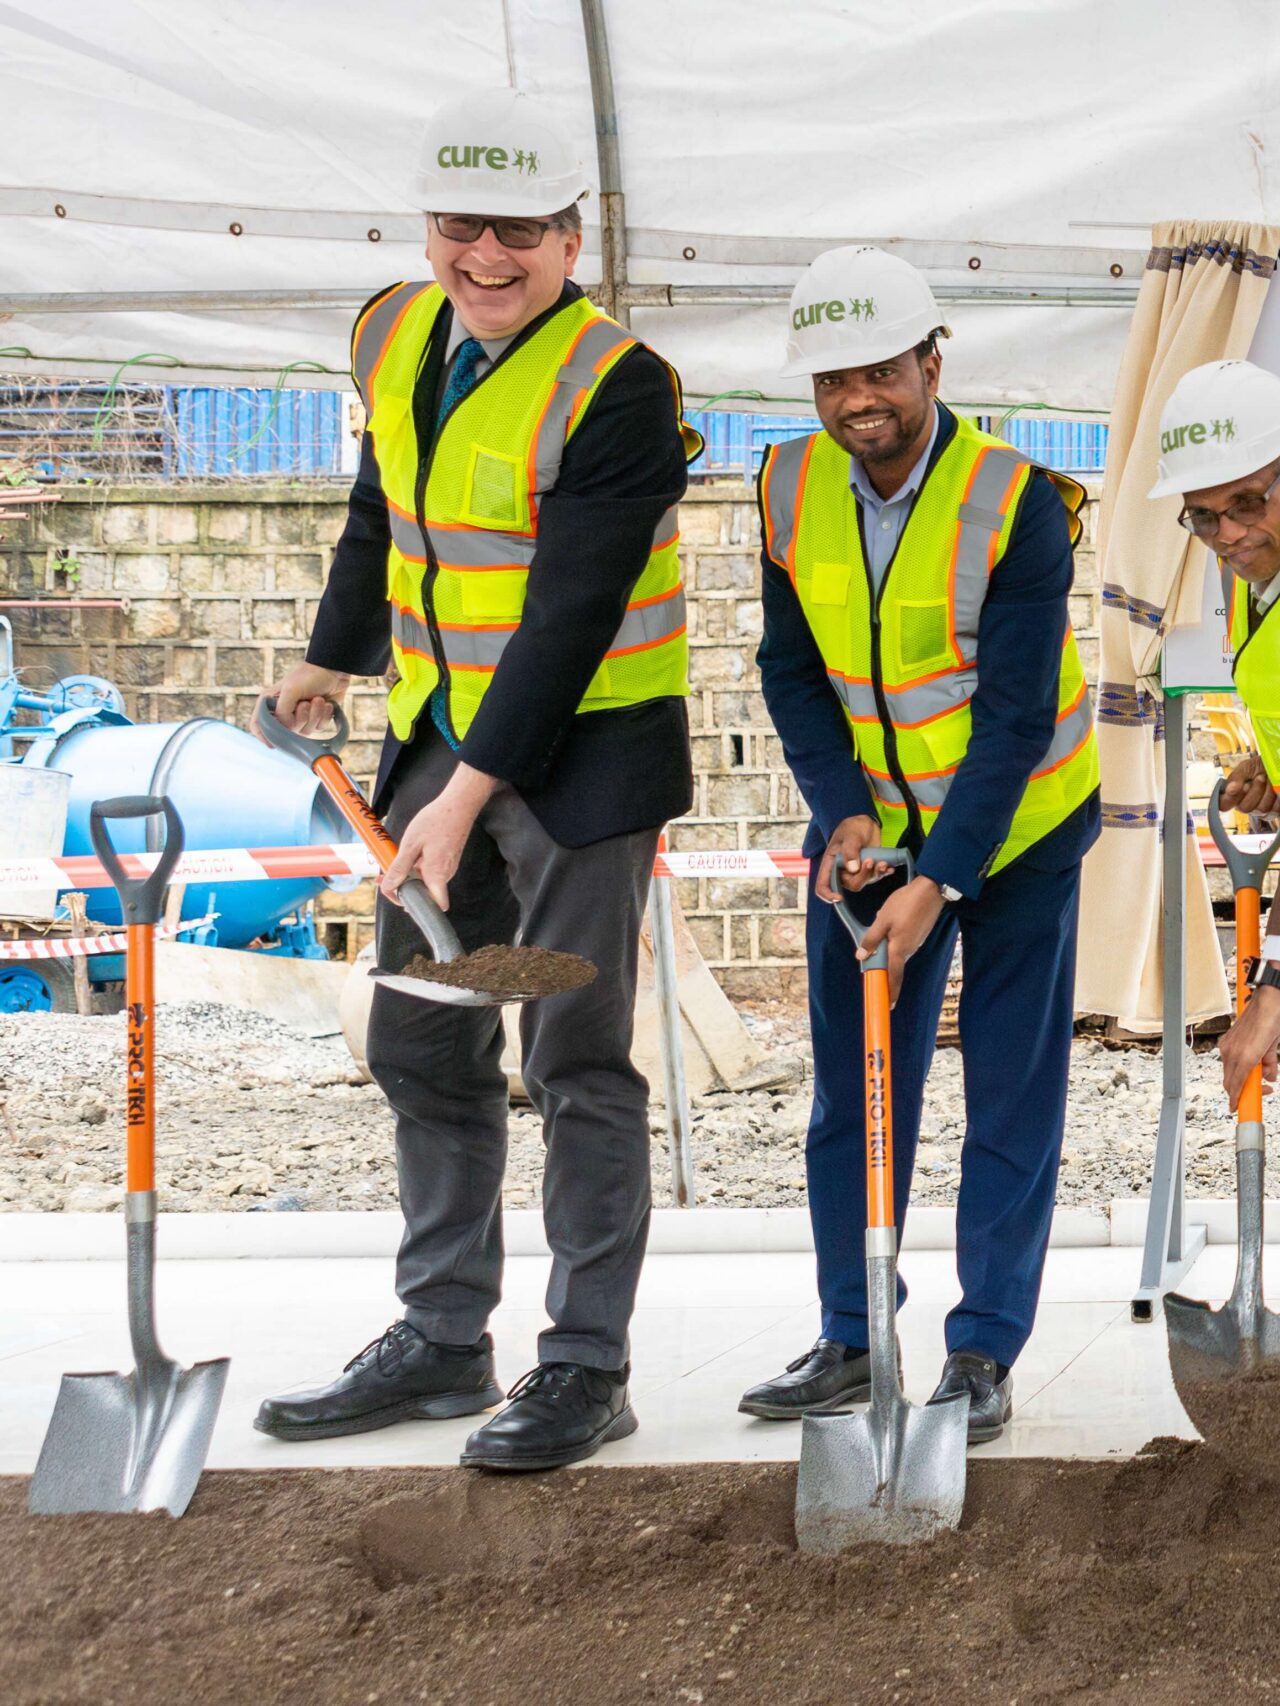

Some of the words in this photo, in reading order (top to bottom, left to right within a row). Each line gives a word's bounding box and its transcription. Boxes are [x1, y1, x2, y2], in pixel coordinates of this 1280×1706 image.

[437, 145, 509, 170] cure
[793, 300, 846, 331] cure
[1161, 422, 1207, 454] cure
[687, 854, 748, 869] CAUTION
